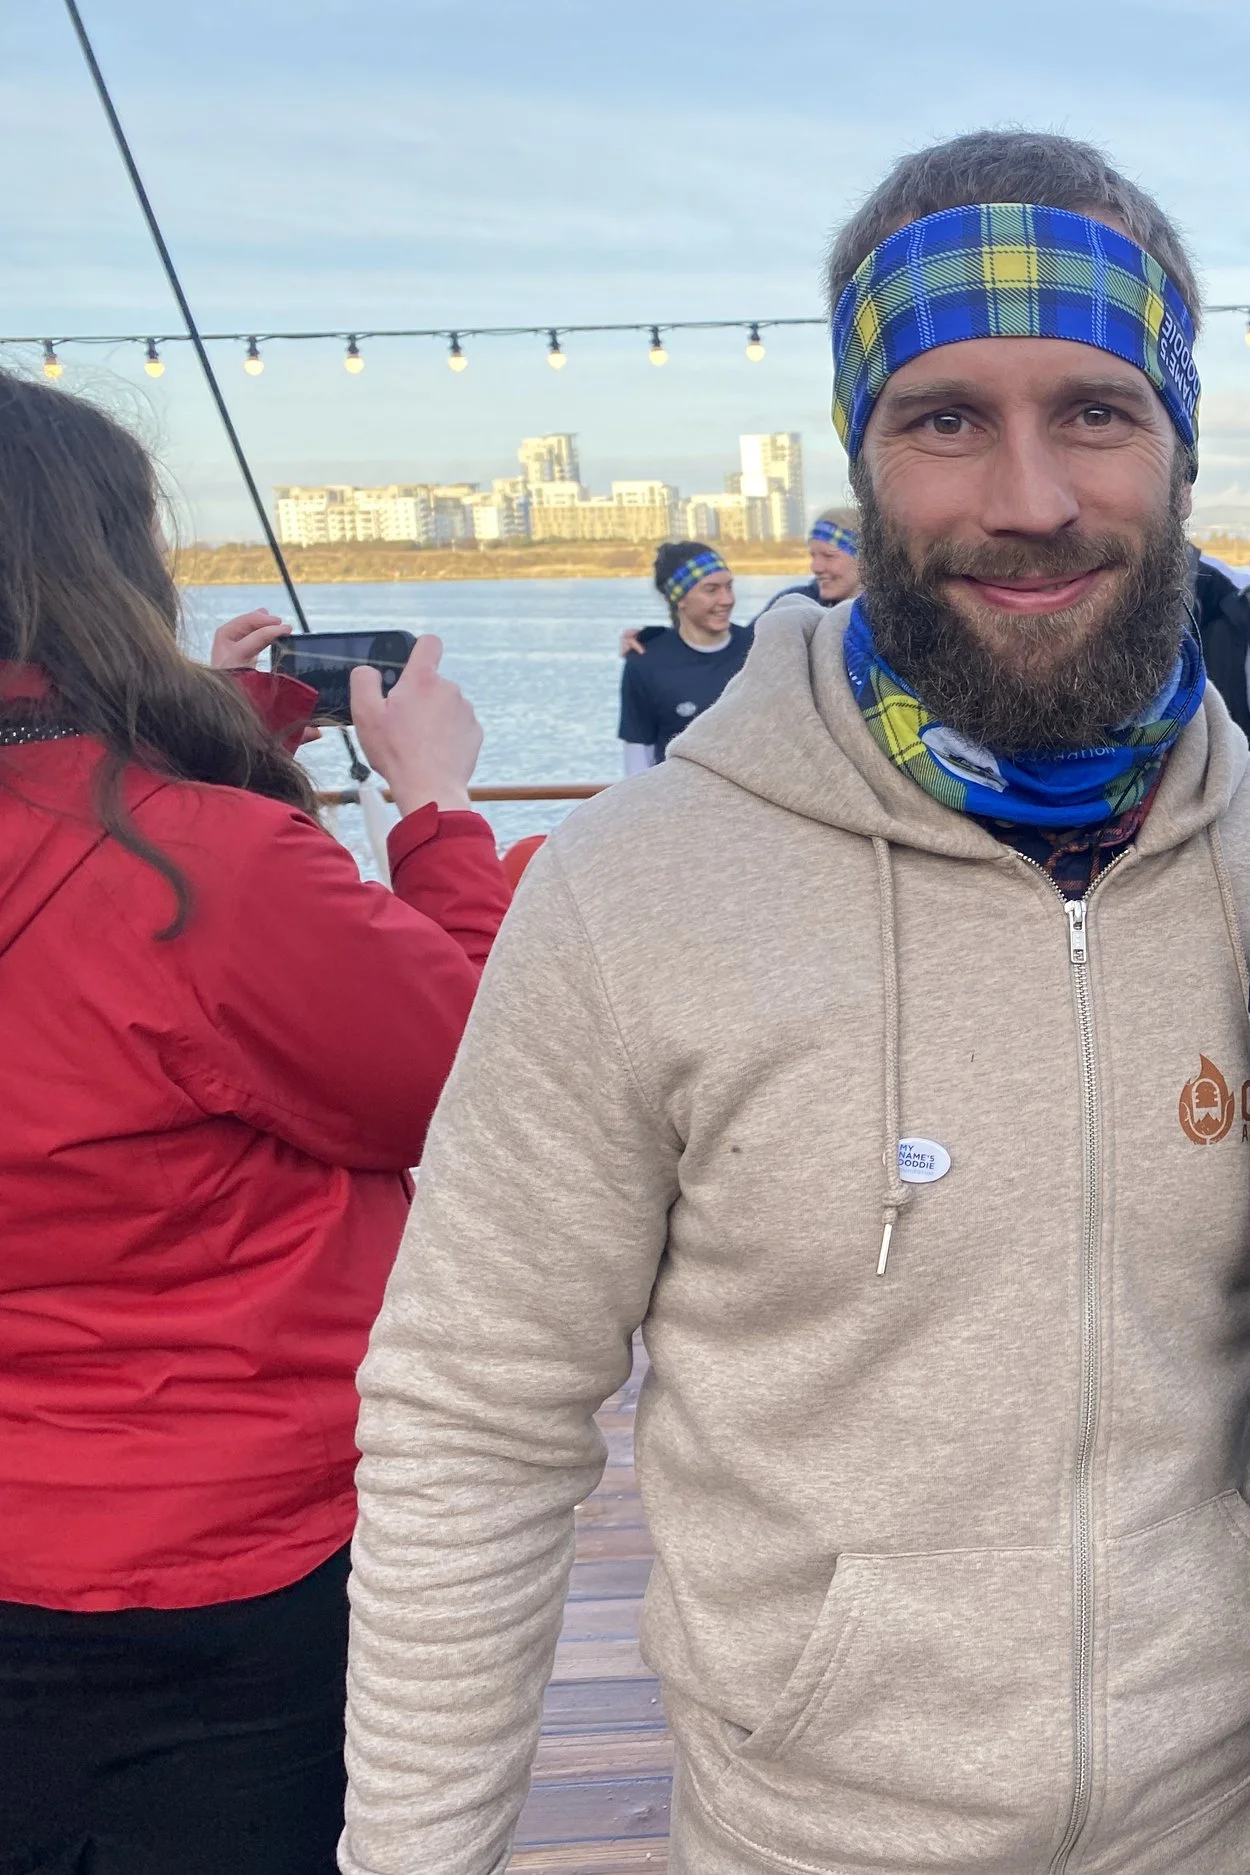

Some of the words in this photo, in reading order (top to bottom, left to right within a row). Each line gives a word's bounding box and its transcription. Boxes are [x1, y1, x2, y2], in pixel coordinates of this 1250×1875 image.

[1160, 337, 1196, 417] NAME'S
[900, 1144, 914, 1152] MY
[898, 1152, 935, 1162] NAME'S
